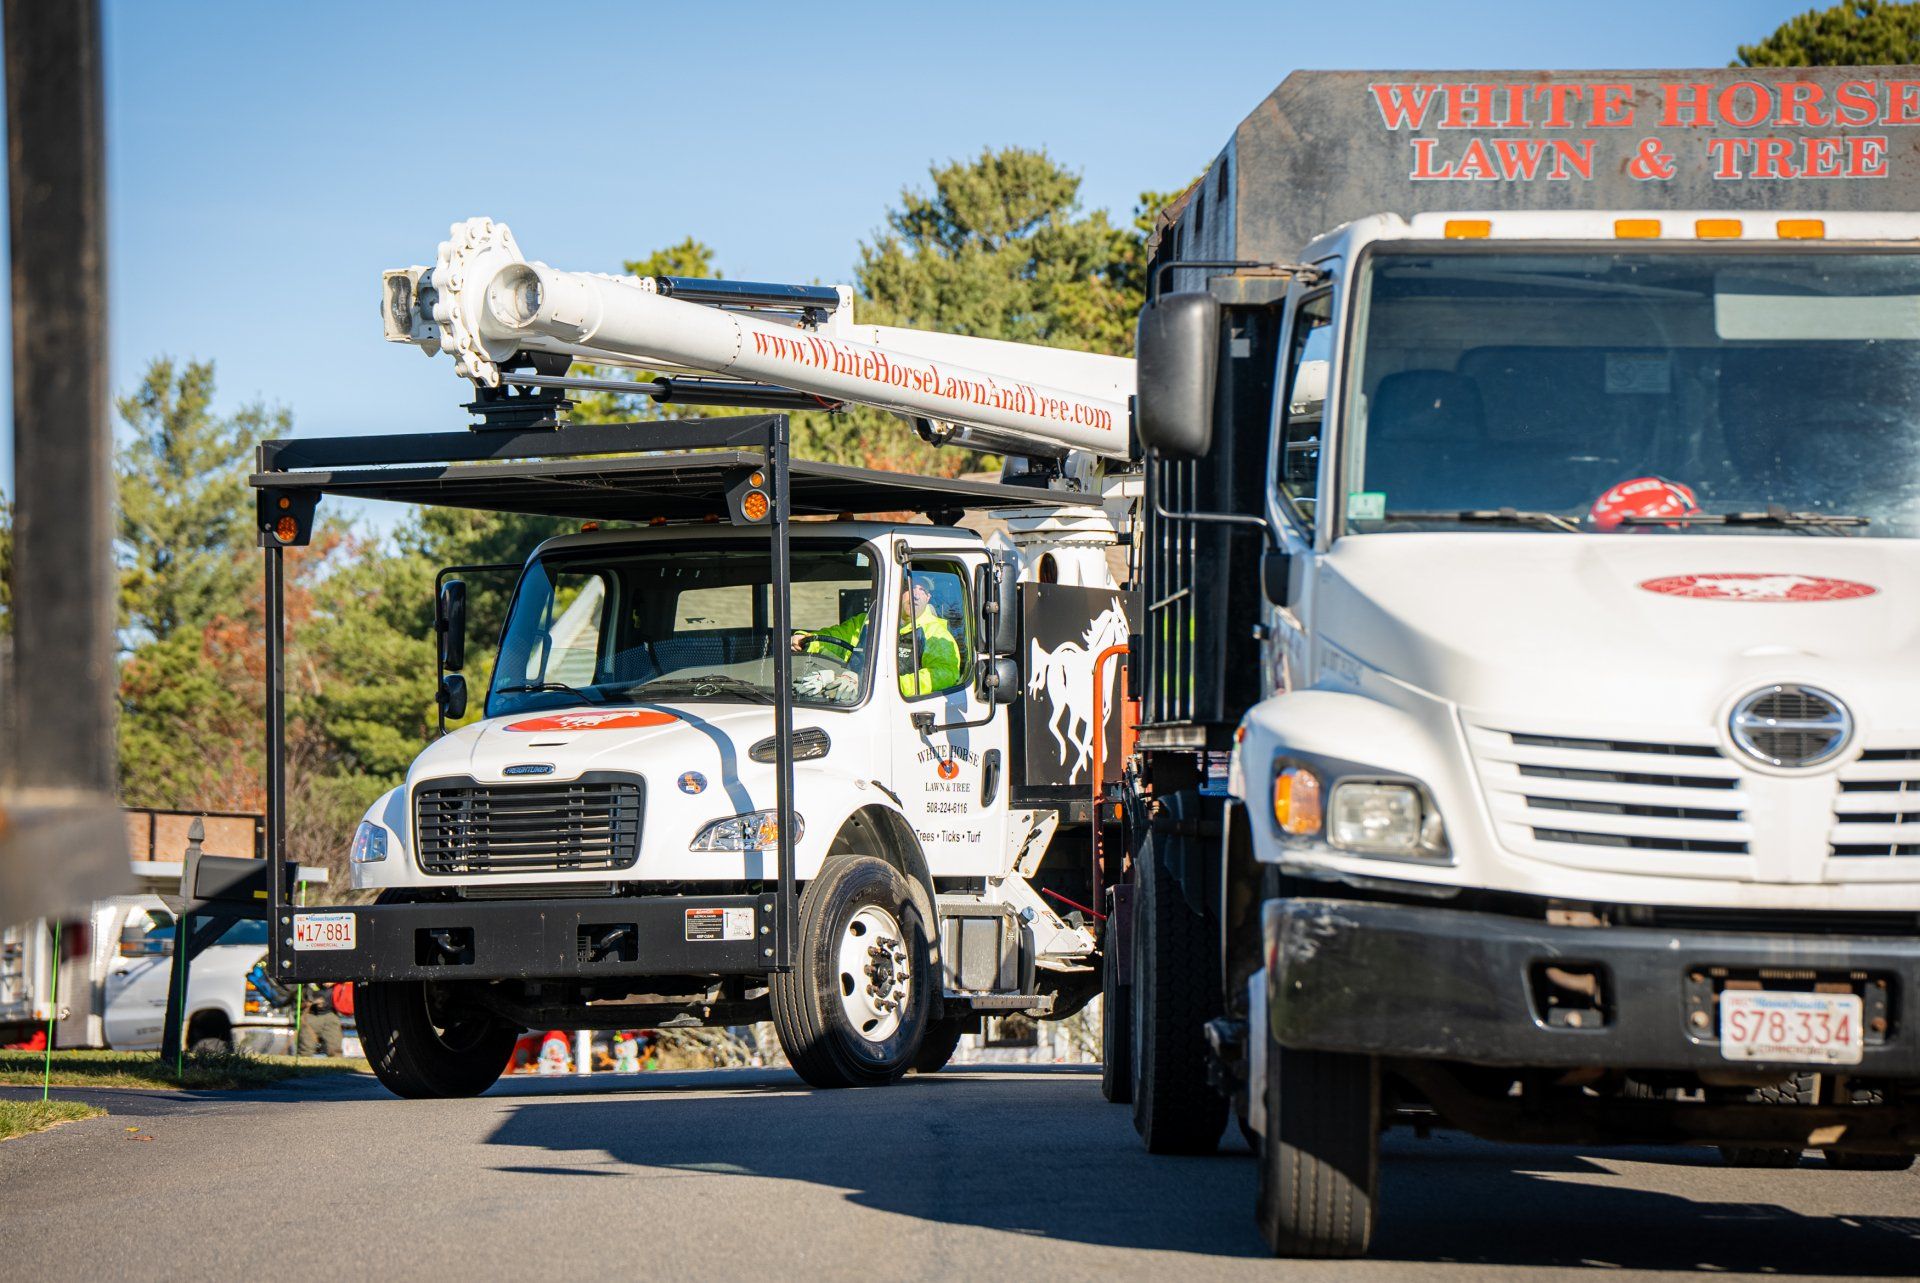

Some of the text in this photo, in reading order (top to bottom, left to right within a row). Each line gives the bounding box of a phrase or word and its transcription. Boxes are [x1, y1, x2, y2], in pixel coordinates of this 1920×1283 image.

[1368, 79, 1920, 130] WHITE HORSE
[1409, 135, 1889, 181] LAWN & TREE
[752, 331, 1113, 431] www.WhiteHorseLawnAndTree.com
[917, 744, 979, 767] WHITE HORSE
[925, 782, 971, 792] LAWN & TREE
[926, 802, 968, 814] 508-224-6116
[915, 829, 981, 843] Trees Ticks Turf
